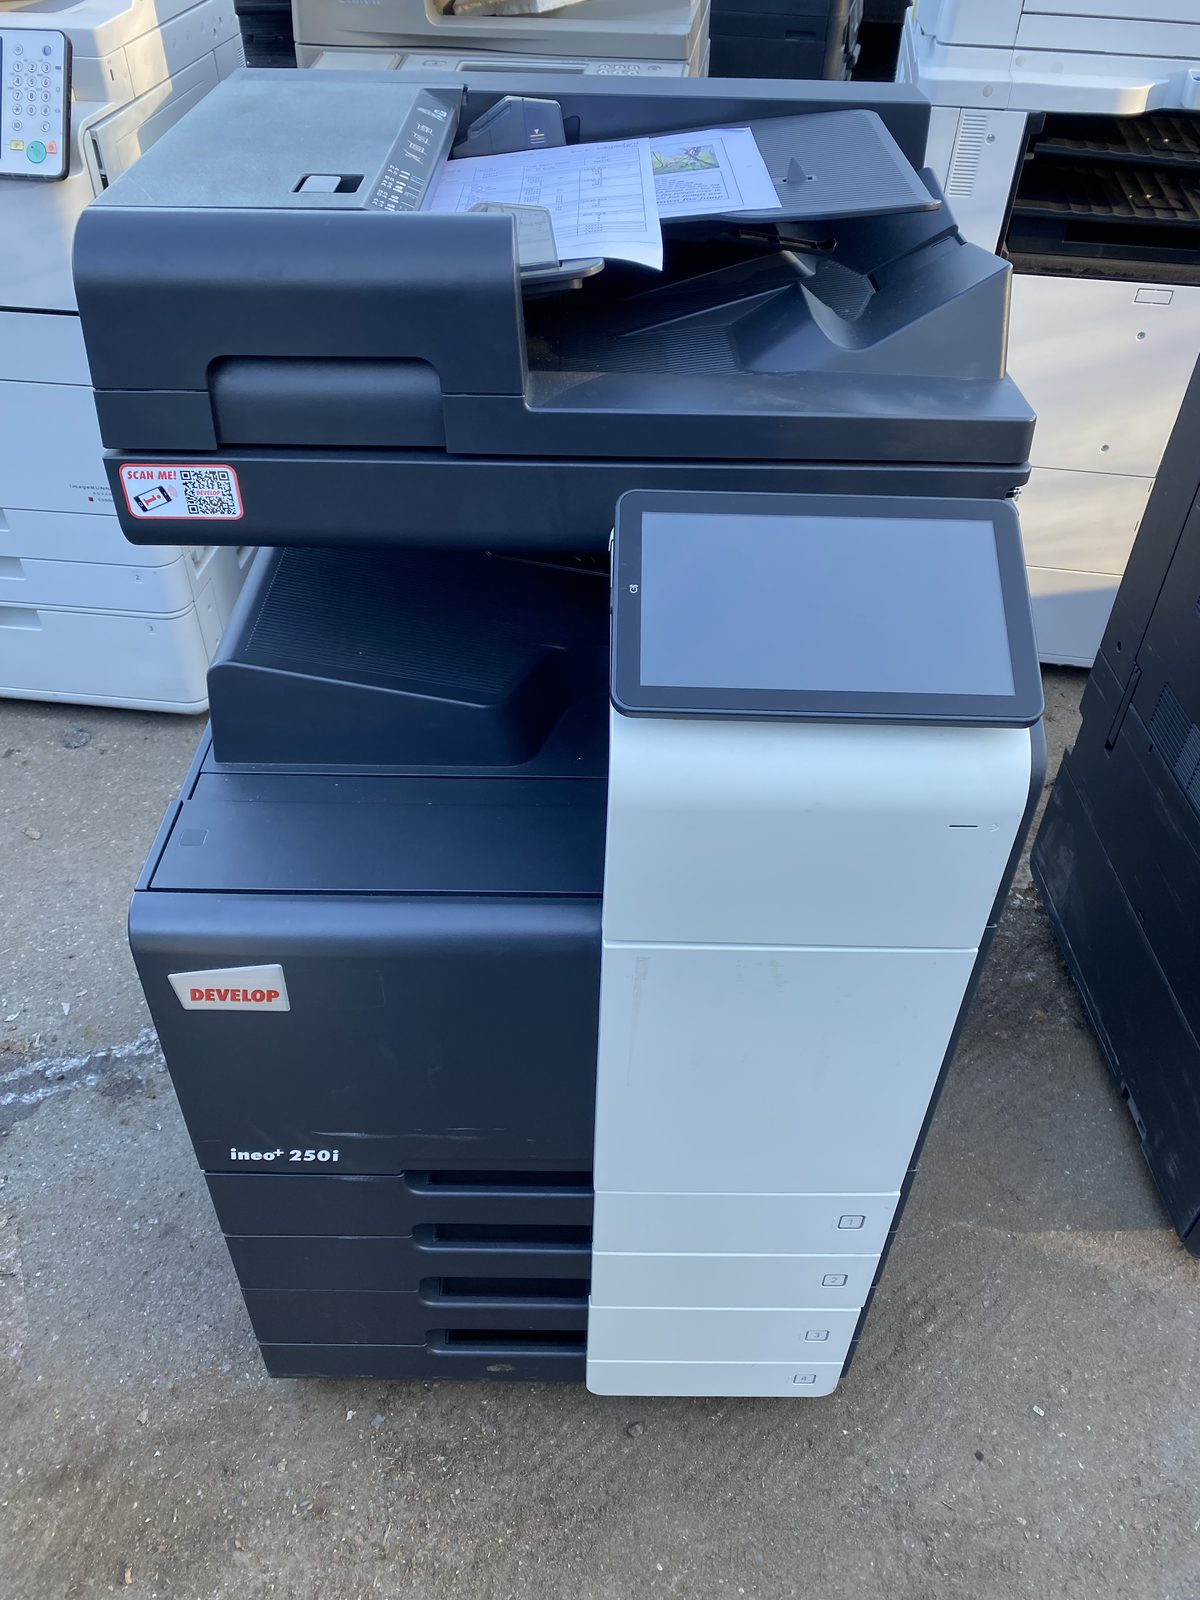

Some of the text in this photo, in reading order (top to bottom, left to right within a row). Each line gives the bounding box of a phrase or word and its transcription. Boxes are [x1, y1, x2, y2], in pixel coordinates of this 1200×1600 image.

[127, 470, 177, 480] SCAN ME!
[196, 489, 222, 497] DEVELOP
[189, 988, 280, 1003] DEVELOP
[288, 1148, 340, 1162] 250i
